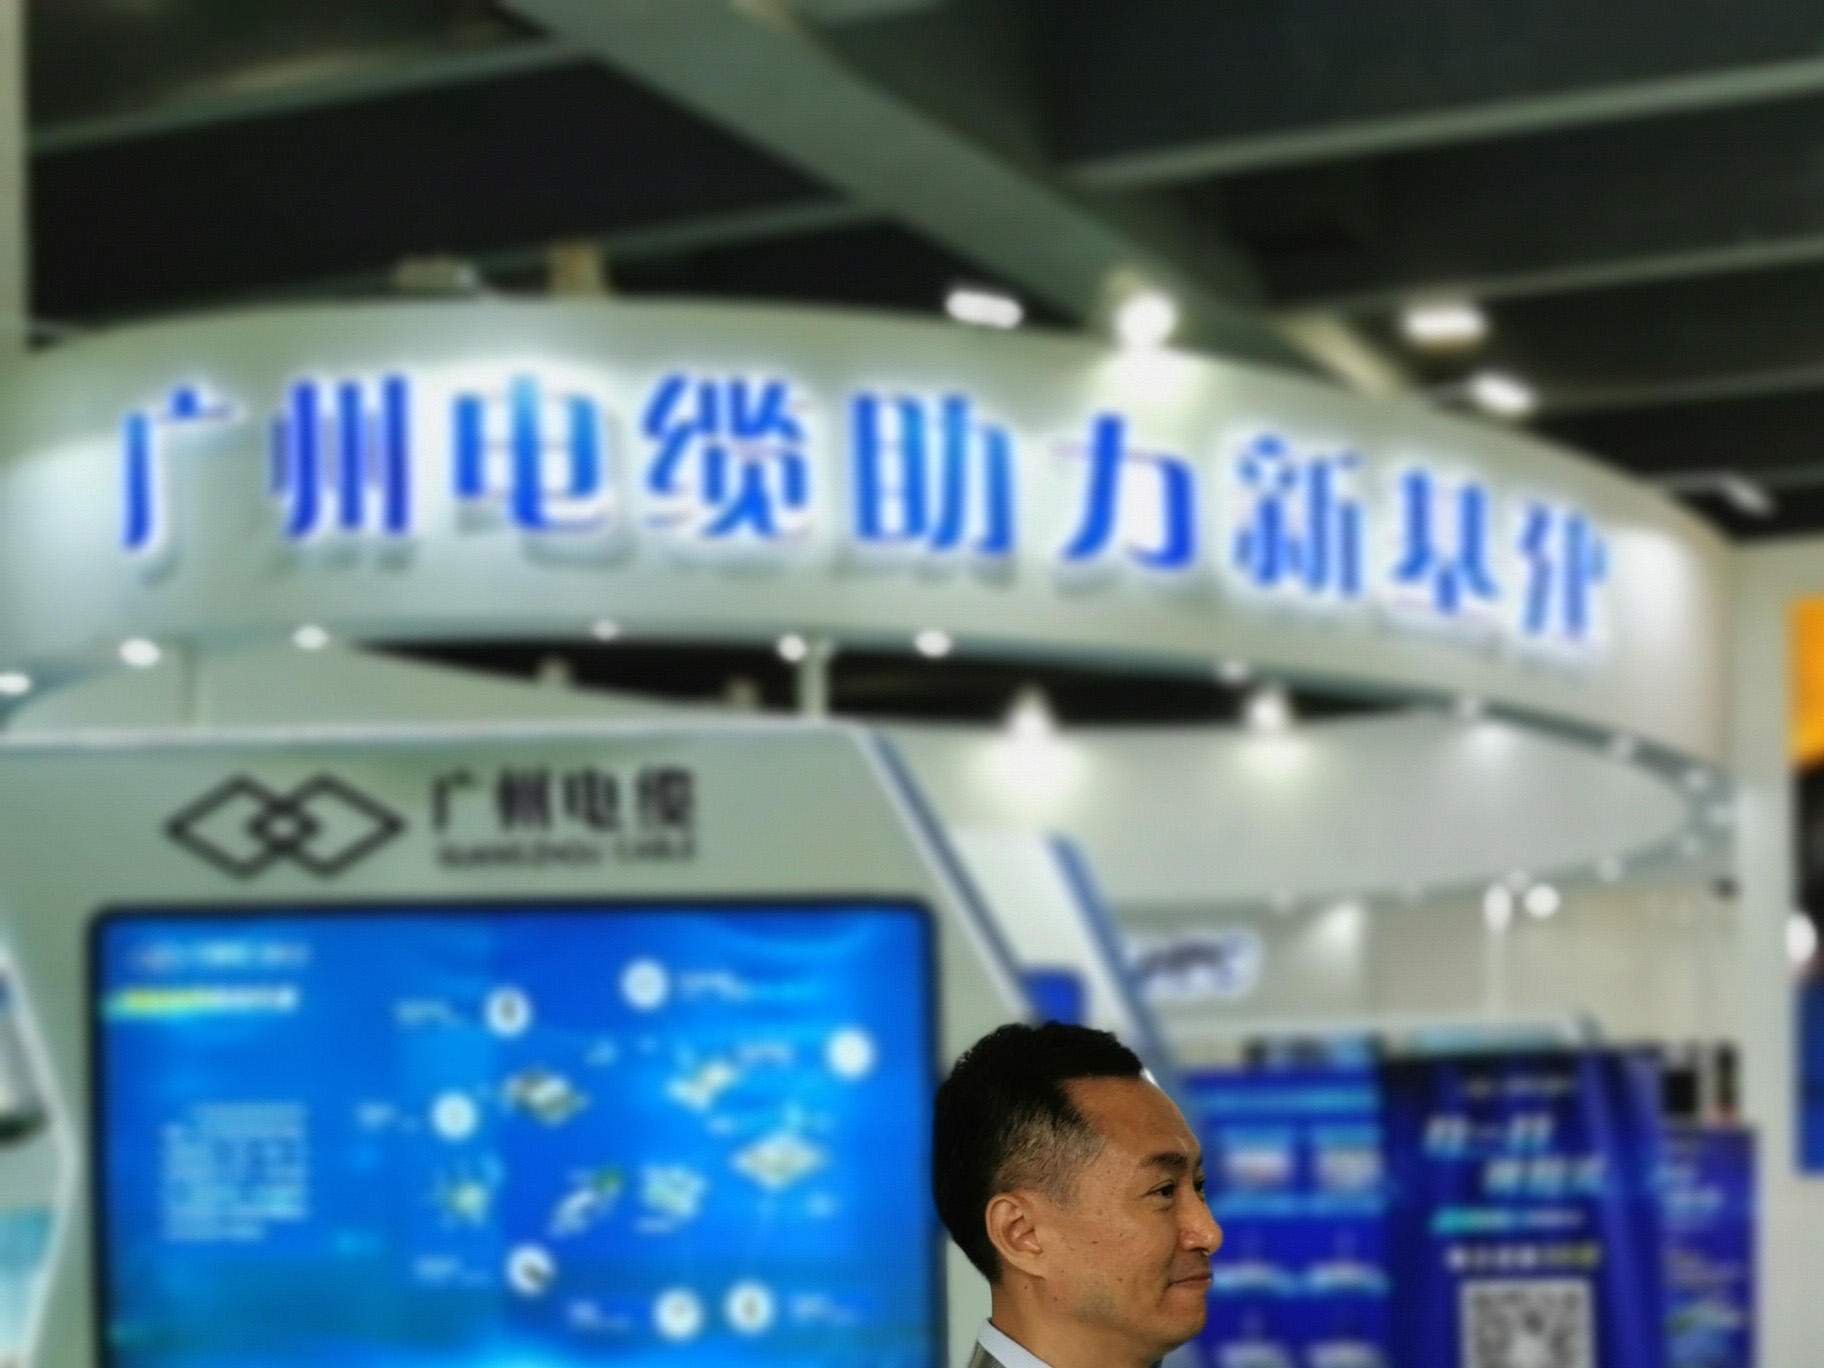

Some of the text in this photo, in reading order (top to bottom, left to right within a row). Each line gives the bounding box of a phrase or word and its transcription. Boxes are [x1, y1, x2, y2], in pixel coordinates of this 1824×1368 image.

[118, 372, 1611, 640] 广州电缆助力新基建
[430, 764, 698, 834] 广州电缆
